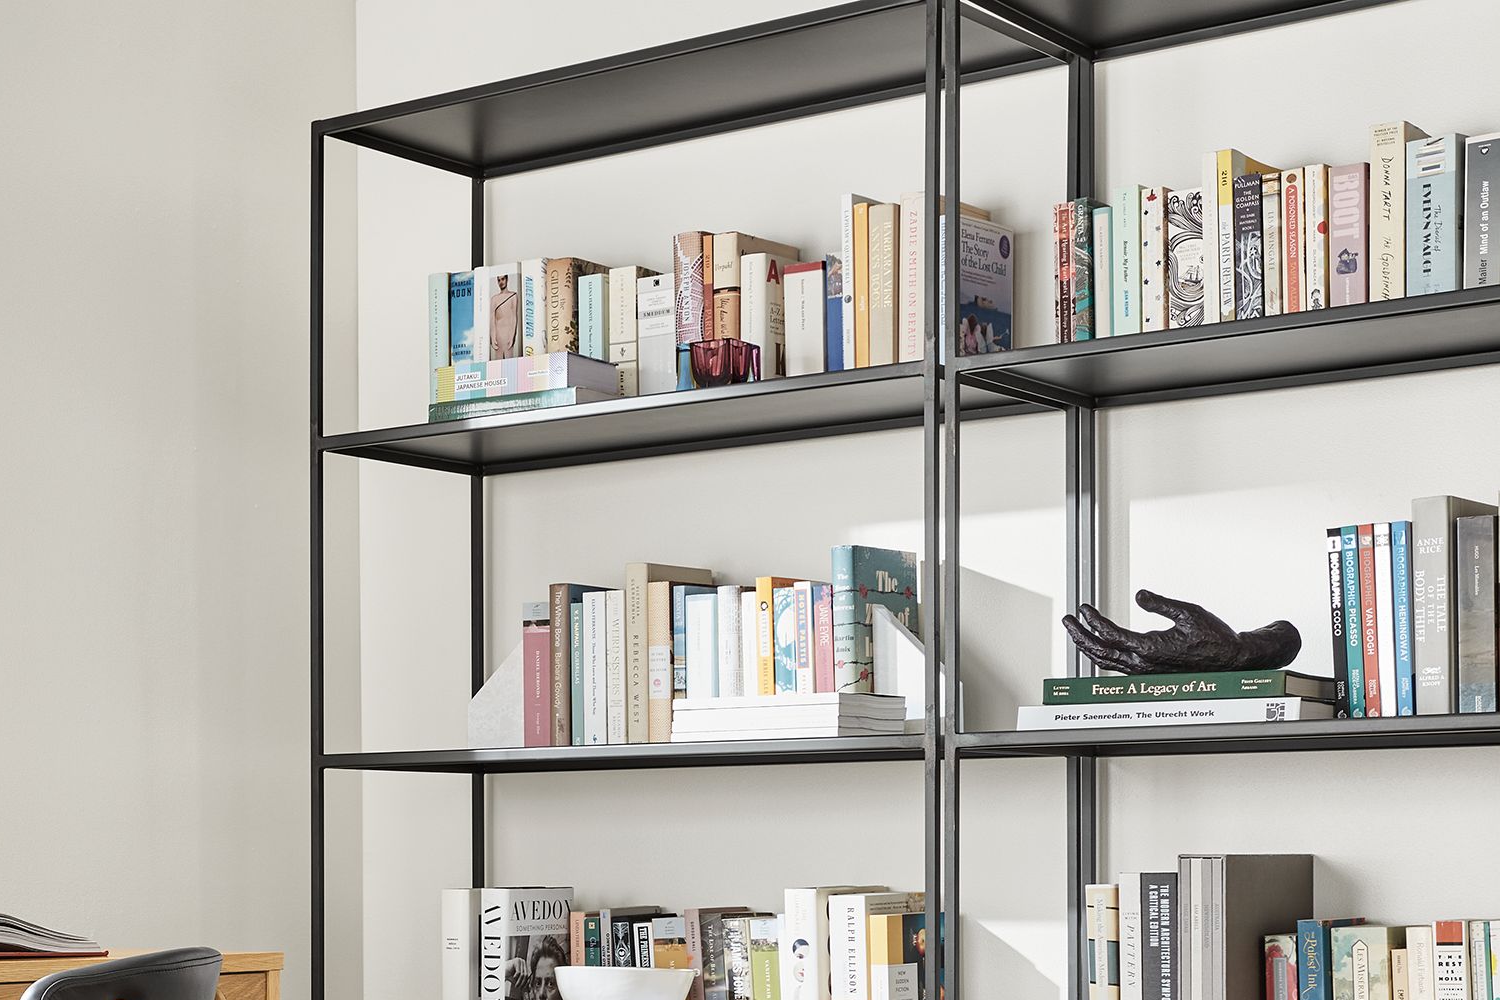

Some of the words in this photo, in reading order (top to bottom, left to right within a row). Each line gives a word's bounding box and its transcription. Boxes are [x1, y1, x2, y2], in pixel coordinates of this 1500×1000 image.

[1234, 179, 1260, 189] PULLMAN
[1381, 156, 1394, 186] DONNA
[1236, 194, 1260, 203] GOLDEN
[1236, 201, 1260, 209] COMPASS
[1382, 190, 1392, 221] TARTT
[1422, 184, 1432, 230] EVELYN
[1480, 180, 1490, 210] Outlaw
[908, 212, 918, 247] ZADIE
[1480, 222, 1488, 232] of
[1482, 212, 1489, 221] an
[884, 222, 892, 278] BARBARA
[962, 228, 974, 240] Elena
[975, 232, 996, 247] Ferrante
[962, 240, 974, 256] The
[974, 244, 990, 261] Story
[1222, 232, 1230, 266] PARIS
[1480, 234, 1488, 255] Mind
[908, 251, 917, 286] SMITH
[1422, 233, 1432, 278] WAUGH
[766, 259, 780, 284] A
[1380, 252, 1394, 300] GOLDFINCH
[1478, 258, 1488, 285] Mailer
[551, 270, 559, 314] GILDED
[884, 281, 892, 308] VINE
[908, 291, 917, 308] ON
[1222, 267, 1231, 306] REVIEW
[551, 315, 560, 342] HOUR
[908, 312, 917, 356] BEAUTY
[456, 372, 480, 382] JUTAKU:
[456, 382, 484, 391] JAPANESE
[484, 379, 506, 388] HOUSES
[1416, 536, 1444, 546] ANNE
[1419, 546, 1442, 554] RICE
[876, 570, 898, 593] The
[1328, 553, 1341, 609] BIOGRAPHIC
[1346, 550, 1355, 606] BIOGRAPHIC
[1364, 550, 1372, 606] BIOGRAPHIC
[1397, 547, 1406, 604] BIOGRAPHIC
[1415, 570, 1424, 602] BODY
[1436, 576, 1446, 600] THE
[1428, 586, 1434, 597] OF
[818, 604, 828, 626] JANE
[1332, 608, 1342, 636] COCO
[1348, 606, 1358, 647] PICASSO
[1366, 608, 1374, 628] VAN
[1416, 604, 1426, 642] THIEF
[1436, 604, 1446, 632] TALE
[820, 626, 830, 647] EYRE
[1366, 628, 1374, 656] GOGH
[1398, 605, 1408, 662] HEMINGWAY
[554, 652, 562, 680] Barbara
[632, 634, 640, 686] REBECCA
[554, 681, 562, 708] Gowdy
[1092, 683, 1124, 695] Freer:
[1127, 682, 1136, 694] A
[1140, 682, 1179, 696] Legacy
[1182, 681, 1196, 692] of
[1197, 680, 1217, 692] Art
[1054, 713, 1080, 722] Pieter
[1082, 712, 1132, 721] Saenredam,
[1136, 711, 1152, 720] The
[1155, 710, 1187, 718] Utrecht
[1190, 708, 1215, 718] Work
[1160, 884, 1170, 897] THE
[1149, 891, 1158, 921] CRITICAL
[1160, 899, 1170, 924] MODERN
[847, 907, 856, 942] RALPH
[1150, 923, 1159, 948] EDITION
[731, 942, 744, 973] JAMES
[1160, 926, 1170, 972] ARCHITECTURE
[848, 948, 856, 994] ELLISON
